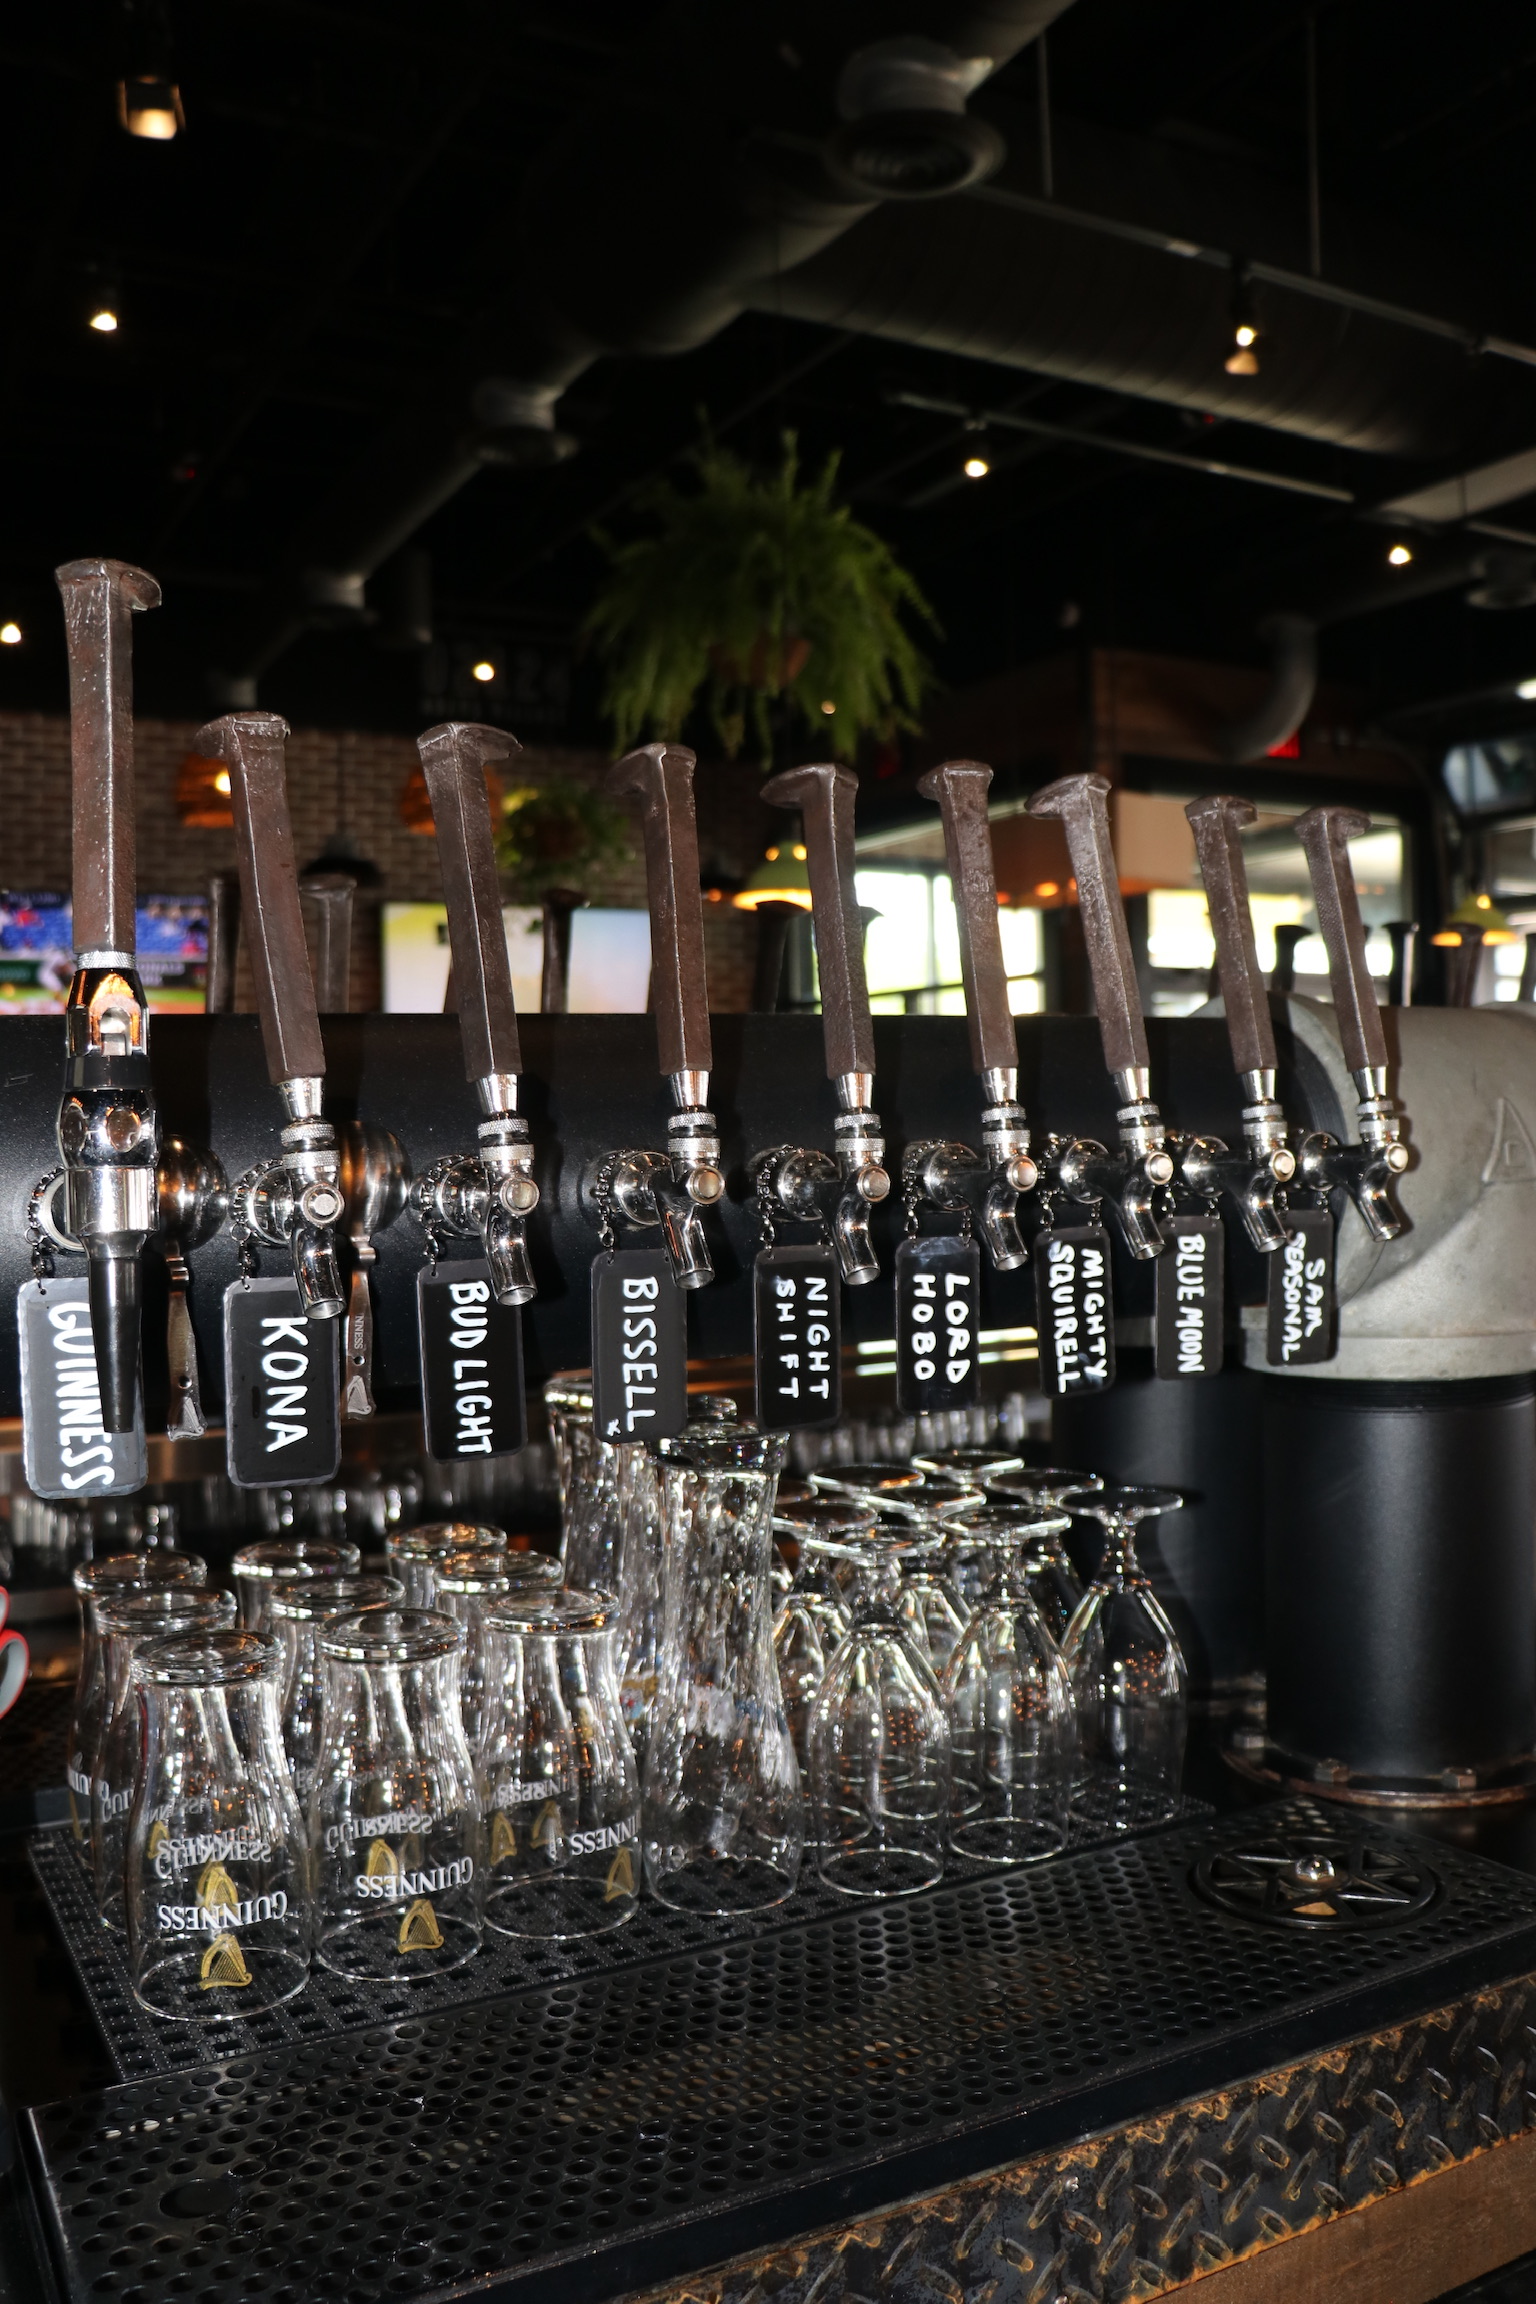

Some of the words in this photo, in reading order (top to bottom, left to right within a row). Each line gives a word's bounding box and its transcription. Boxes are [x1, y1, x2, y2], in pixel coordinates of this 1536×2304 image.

[448, 1280, 491, 1351] BUD
[1049, 1240, 1081, 1394] SQUIRELL
[1081, 1248, 1108, 1379] MIGHTY
[1175, 1233, 1206, 1302] BLUE
[1281, 1231, 1307, 1361] SEASONAL
[1304, 1257, 1327, 1338] SAM
[353, 1313, 365, 1350] NNESS
[622, 1276, 659, 1433] BISSELL
[775, 1278, 799, 1399] SHIFT
[804, 1276, 831, 1400] NIGHT
[911, 1273, 937, 1381] HOBO
[945, 1273, 971, 1384] LORD
[1174, 1306, 1206, 1374] MOON
[48, 1302, 117, 1490] GUINNESS
[260, 1316, 309, 1453] KONA
[453, 1359, 493, 1455] LIGHT
[158, 1890, 288, 1931] GUINNESS
[355, 1856, 474, 1899] GUINNESS
